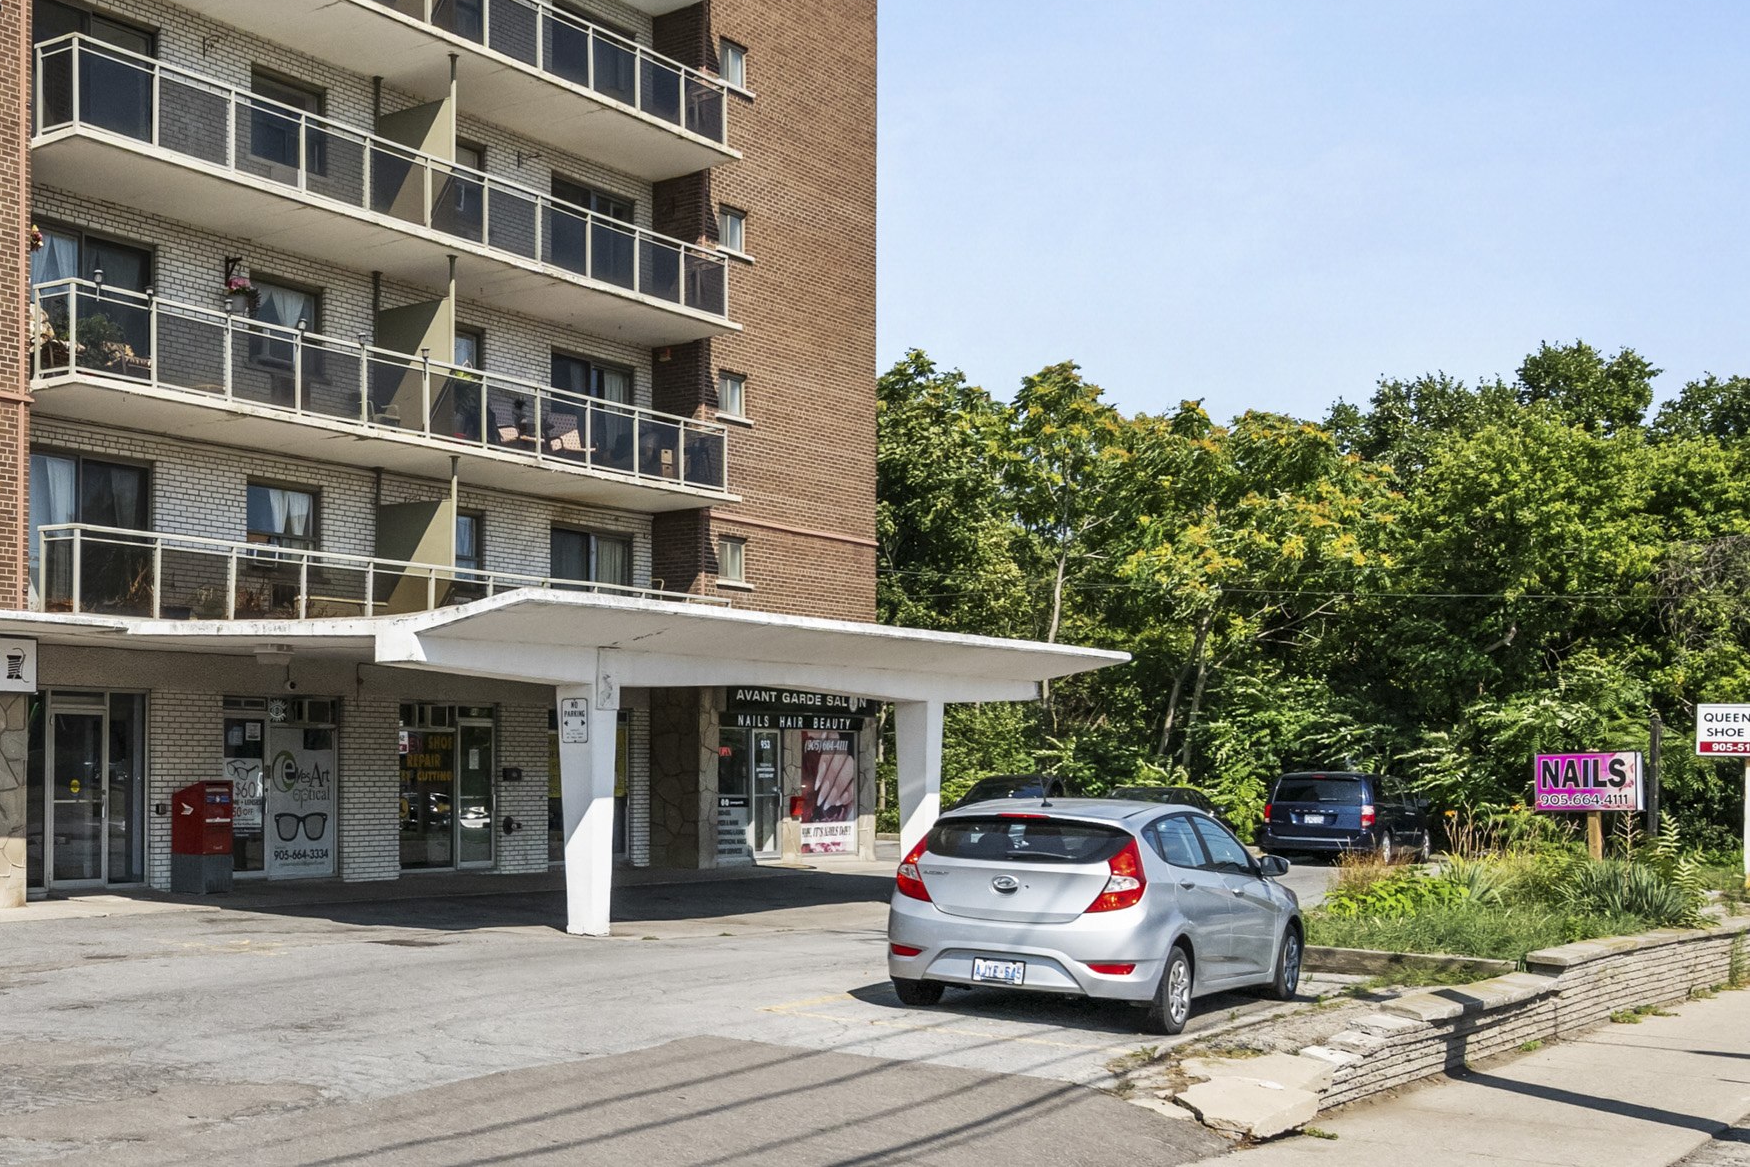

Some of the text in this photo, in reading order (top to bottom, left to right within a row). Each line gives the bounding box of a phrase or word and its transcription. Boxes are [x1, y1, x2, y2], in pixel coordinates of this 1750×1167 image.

[736, 689, 777, 703] AVANT
[782, 692, 822, 706] GARDE
[570, 701, 578, 709] NO
[563, 710, 585, 718] PARKING
[737, 714, 851, 730] NAILS HAIR BEAUTY
[1706, 728, 1745, 737] SHOE
[428, 735, 454, 749] SHOE
[760, 740, 771, 749] 953
[406, 754, 441, 768] REPAIR
[417, 769, 454, 782] CUTTING
[1542, 758, 1627, 788] NAILS
[235, 781, 256, 799] $60
[293, 786, 331, 809] optical
[1541, 794, 1628, 806] 905.664.4111
[274, 849, 329, 861] 905-664-3334
